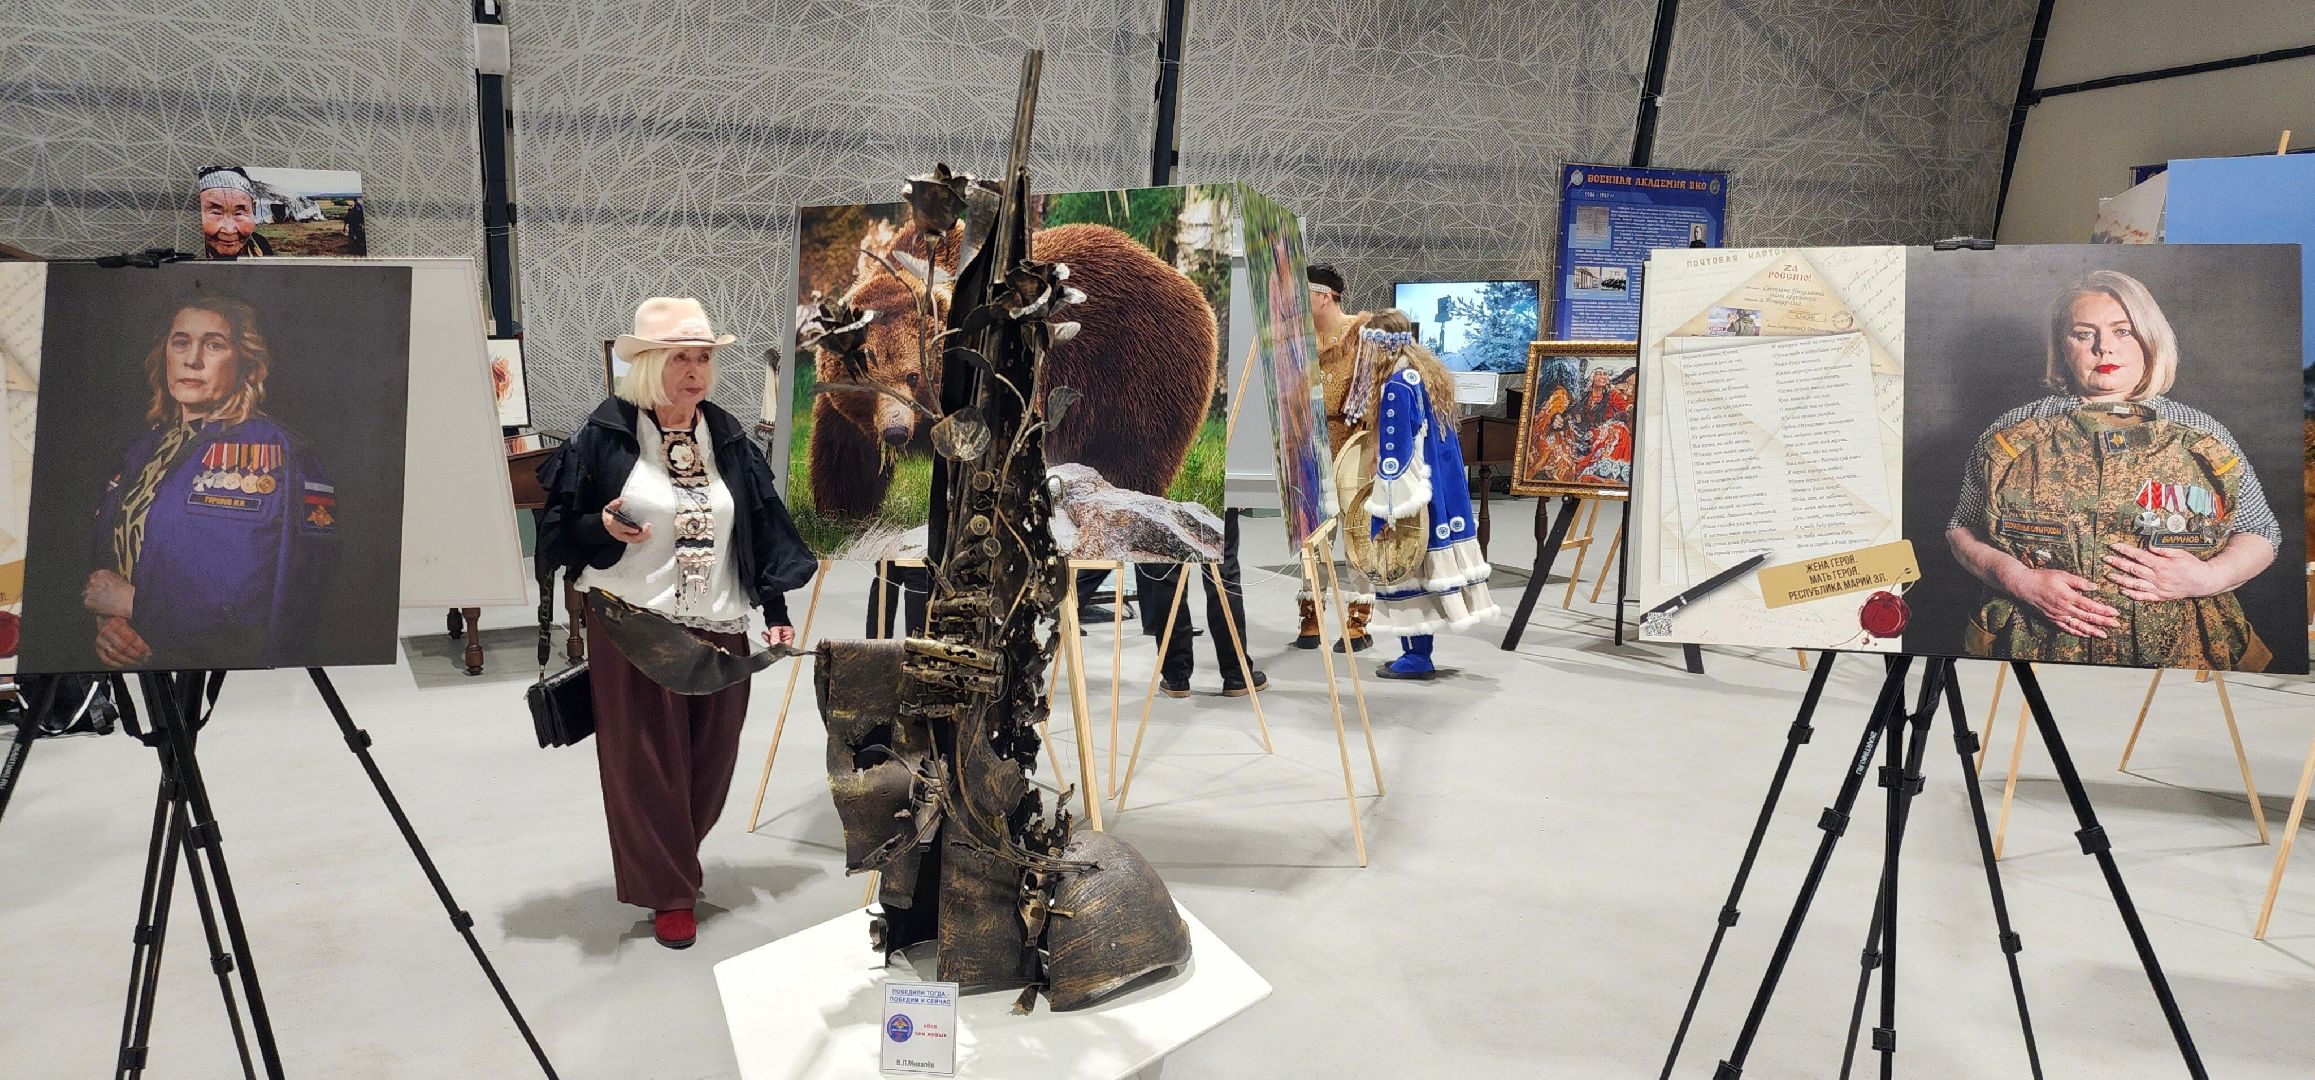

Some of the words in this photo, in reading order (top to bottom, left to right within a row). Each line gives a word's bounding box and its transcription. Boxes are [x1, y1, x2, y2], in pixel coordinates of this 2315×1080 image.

[1587, 174, 1632, 186] ВОЕННАЯ
[1635, 177, 1686, 190] АКАДЕМИЯ
[1689, 181, 1708, 191] ВКО
[1686, 254, 1738, 268] ПОЧТОВАЯ
[2161, 535, 2200, 544] БАРАНОВ
[1805, 559, 1830, 573] ЖЕНА
[1831, 554, 1859, 569] ГЕРОЯ.
[1809, 573, 1832, 584] МАТЬ
[1833, 566, 1861, 580] ГЕРОЯ.
[1788, 581, 1843, 601] РЕСПУБЛИКА
[1844, 574, 1872, 590] МАРИЙ
[889, 996, 919, 1004] ПОБЕДИМ
[926, 997, 951, 1005] СЕЙЧАС
[891, 988, 925, 996] ПОБЕДИЛИ
[926, 990, 946, 998] ТОГДА
